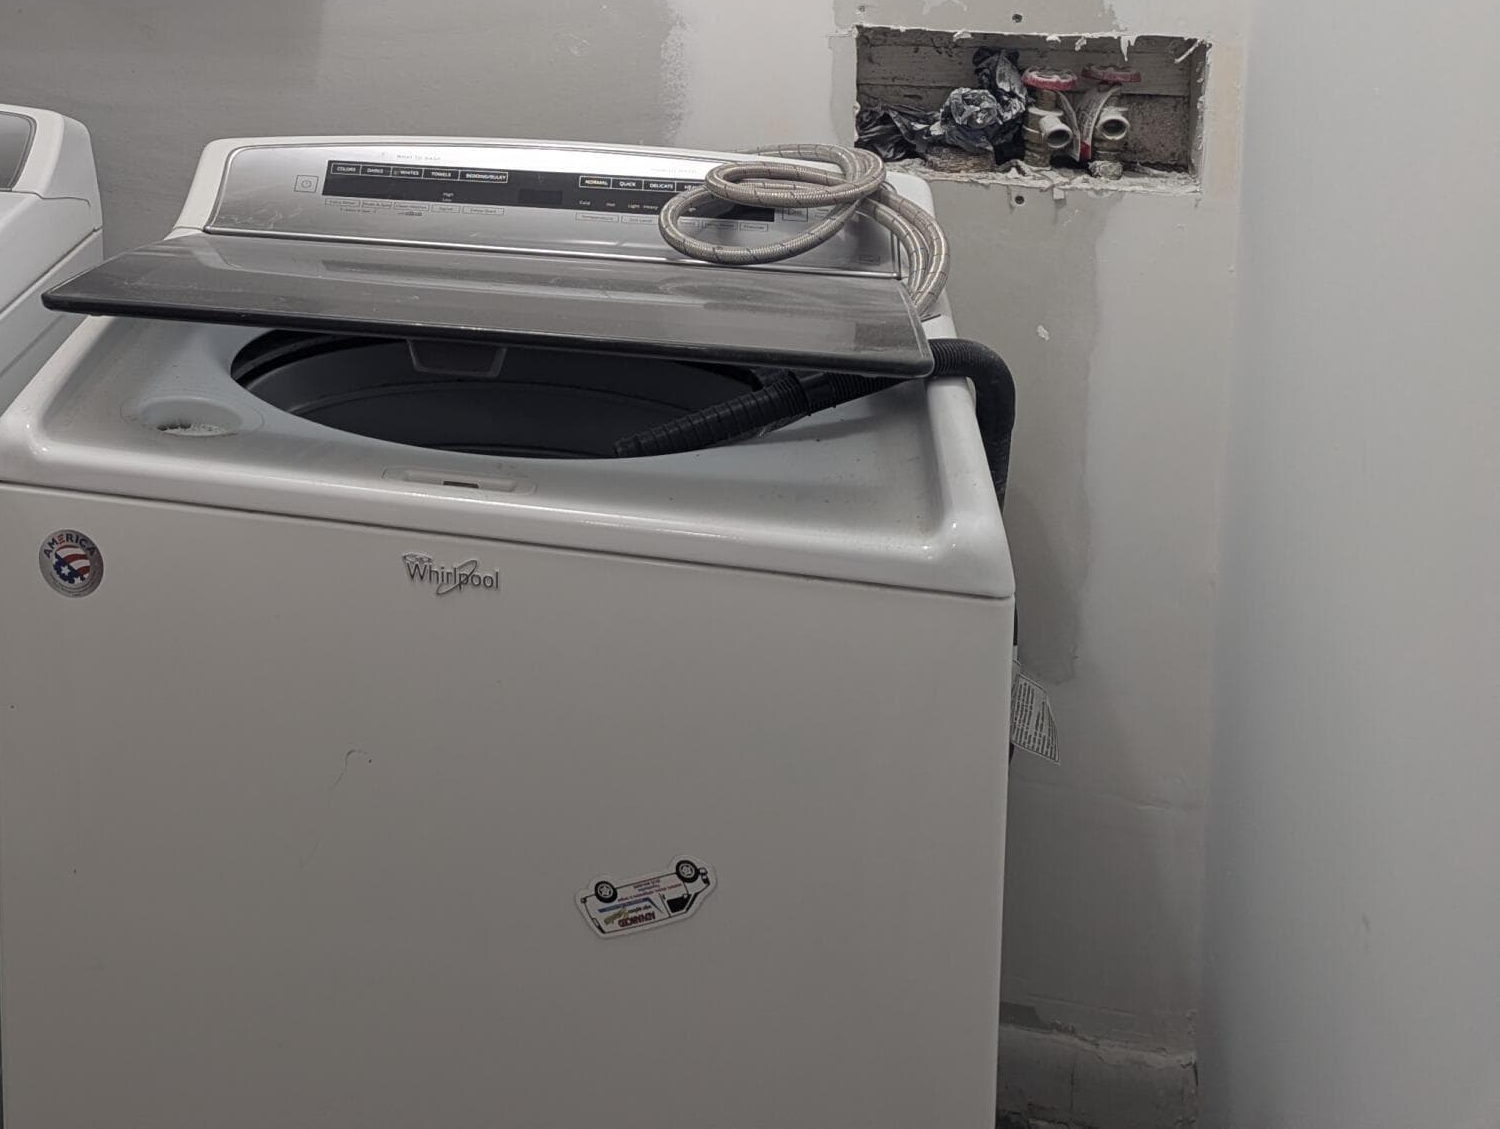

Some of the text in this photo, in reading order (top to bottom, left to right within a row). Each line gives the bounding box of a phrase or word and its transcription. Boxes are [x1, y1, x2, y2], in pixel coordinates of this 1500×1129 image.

[584, 179, 608, 187] NORMAL
[649, 182, 674, 190] DELICATE
[43, 533, 97, 559] AMERICA
[403, 555, 499, 594] Whirlpool
